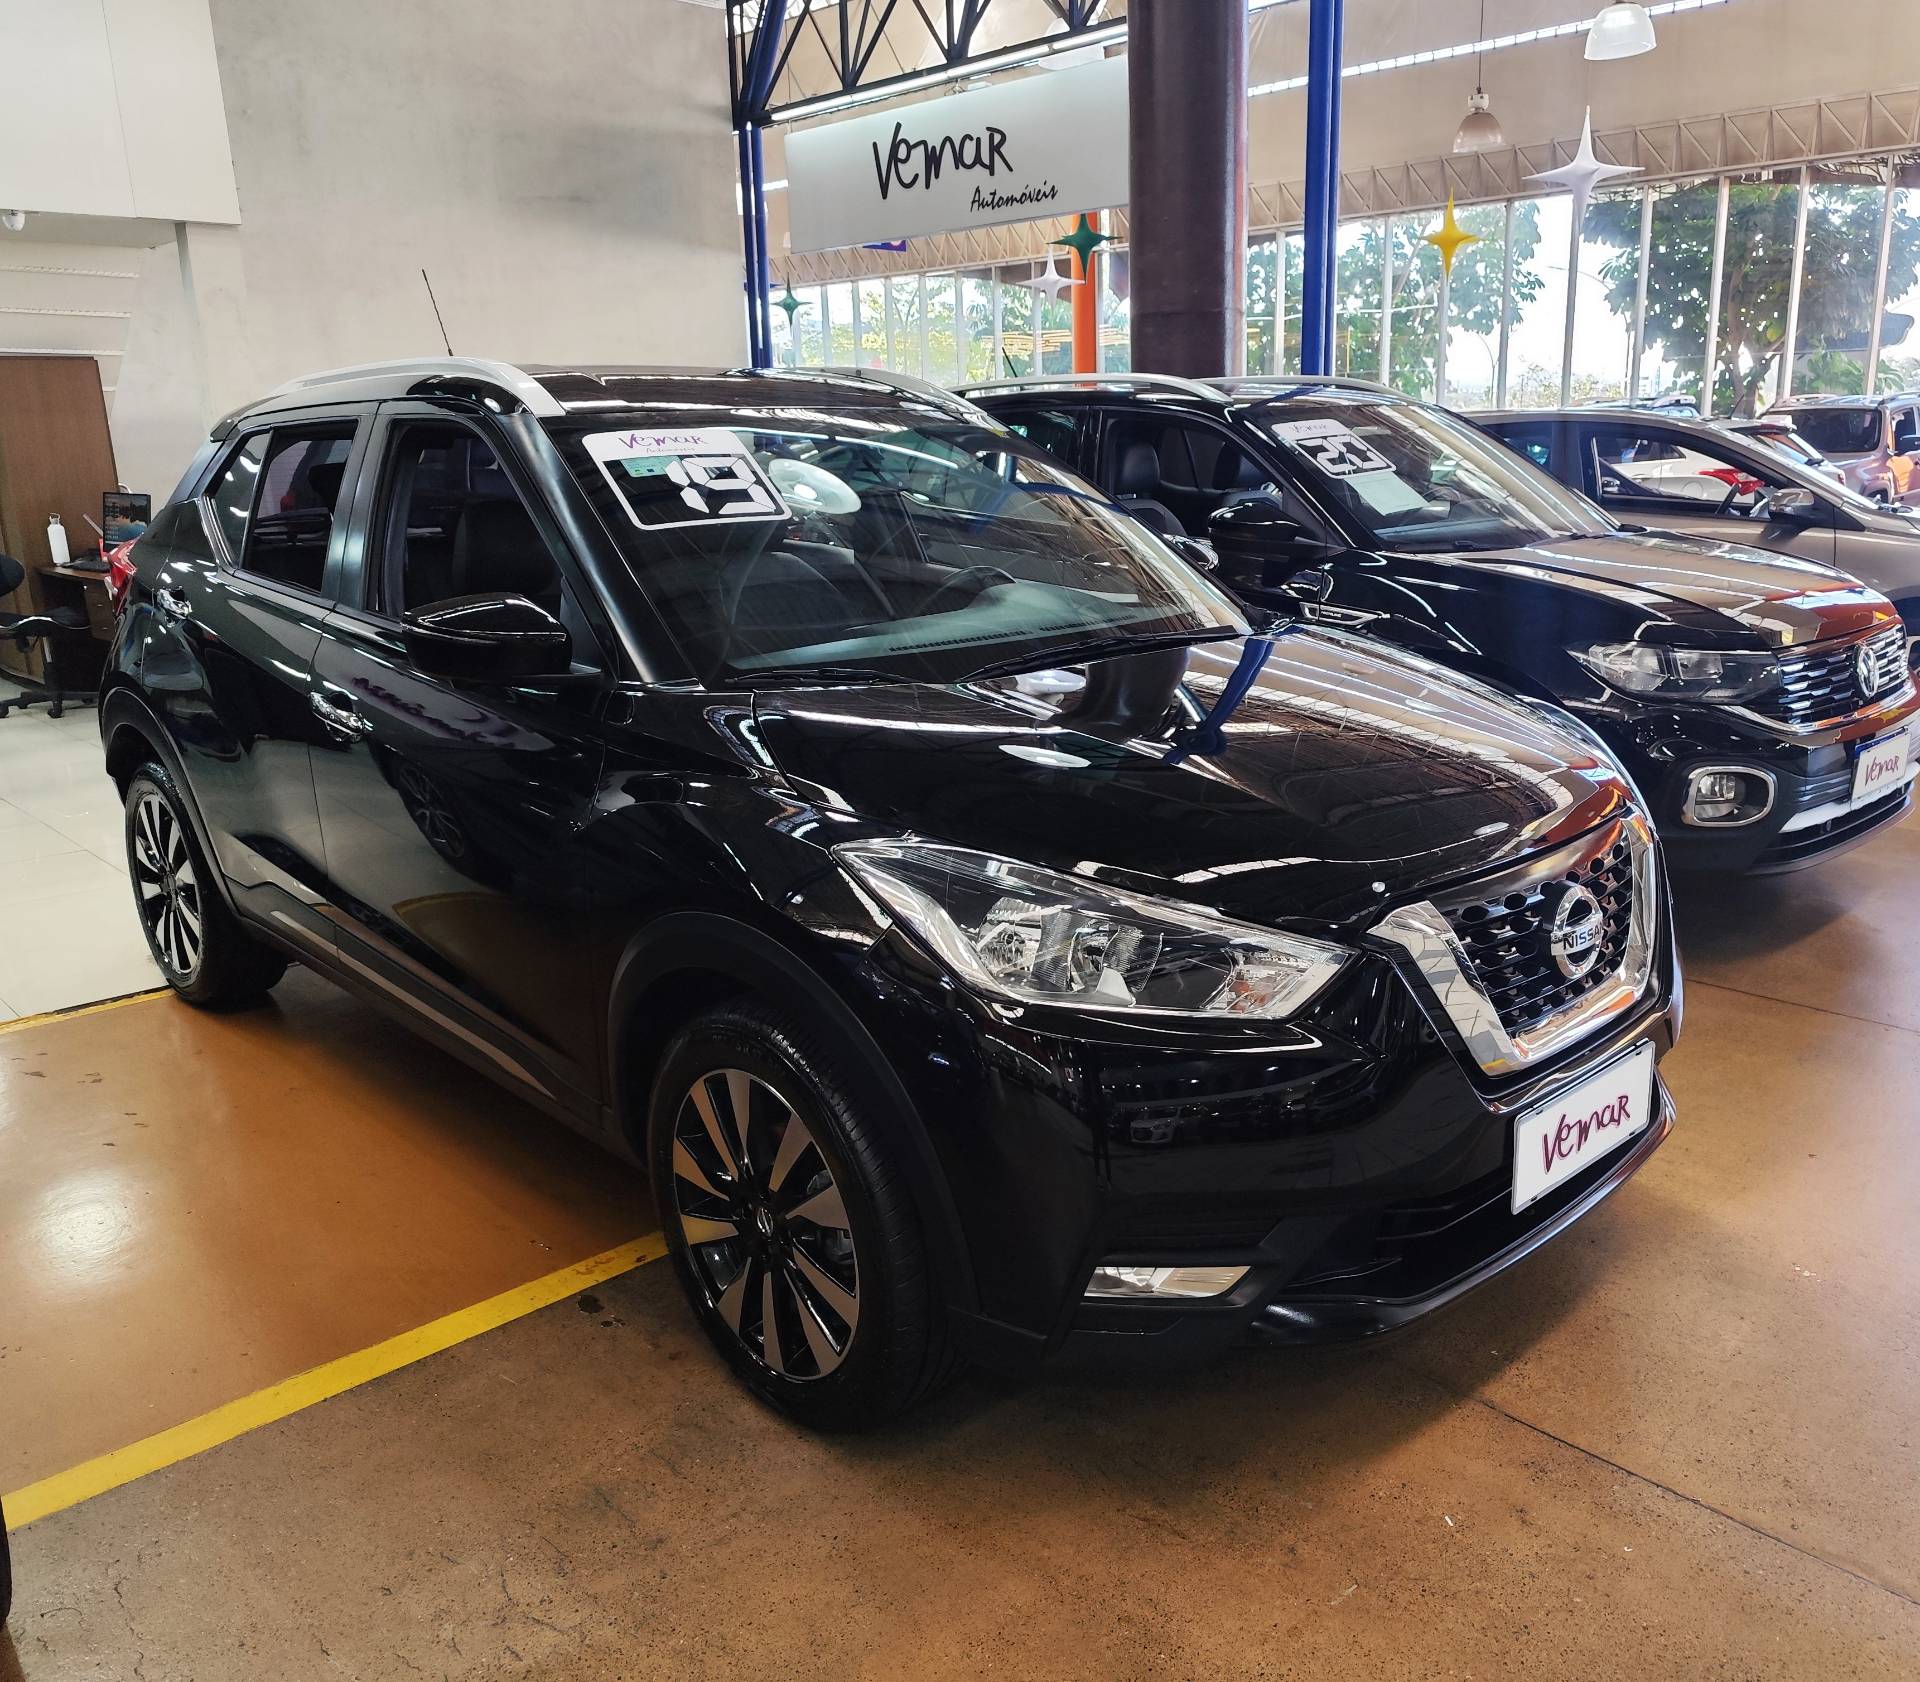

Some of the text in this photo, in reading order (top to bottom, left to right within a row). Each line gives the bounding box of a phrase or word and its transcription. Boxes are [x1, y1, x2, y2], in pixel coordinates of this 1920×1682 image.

[969, 180, 1059, 212] Automóveis
[1297, 435, 1388, 474] 20
[664, 456, 777, 514] 19
